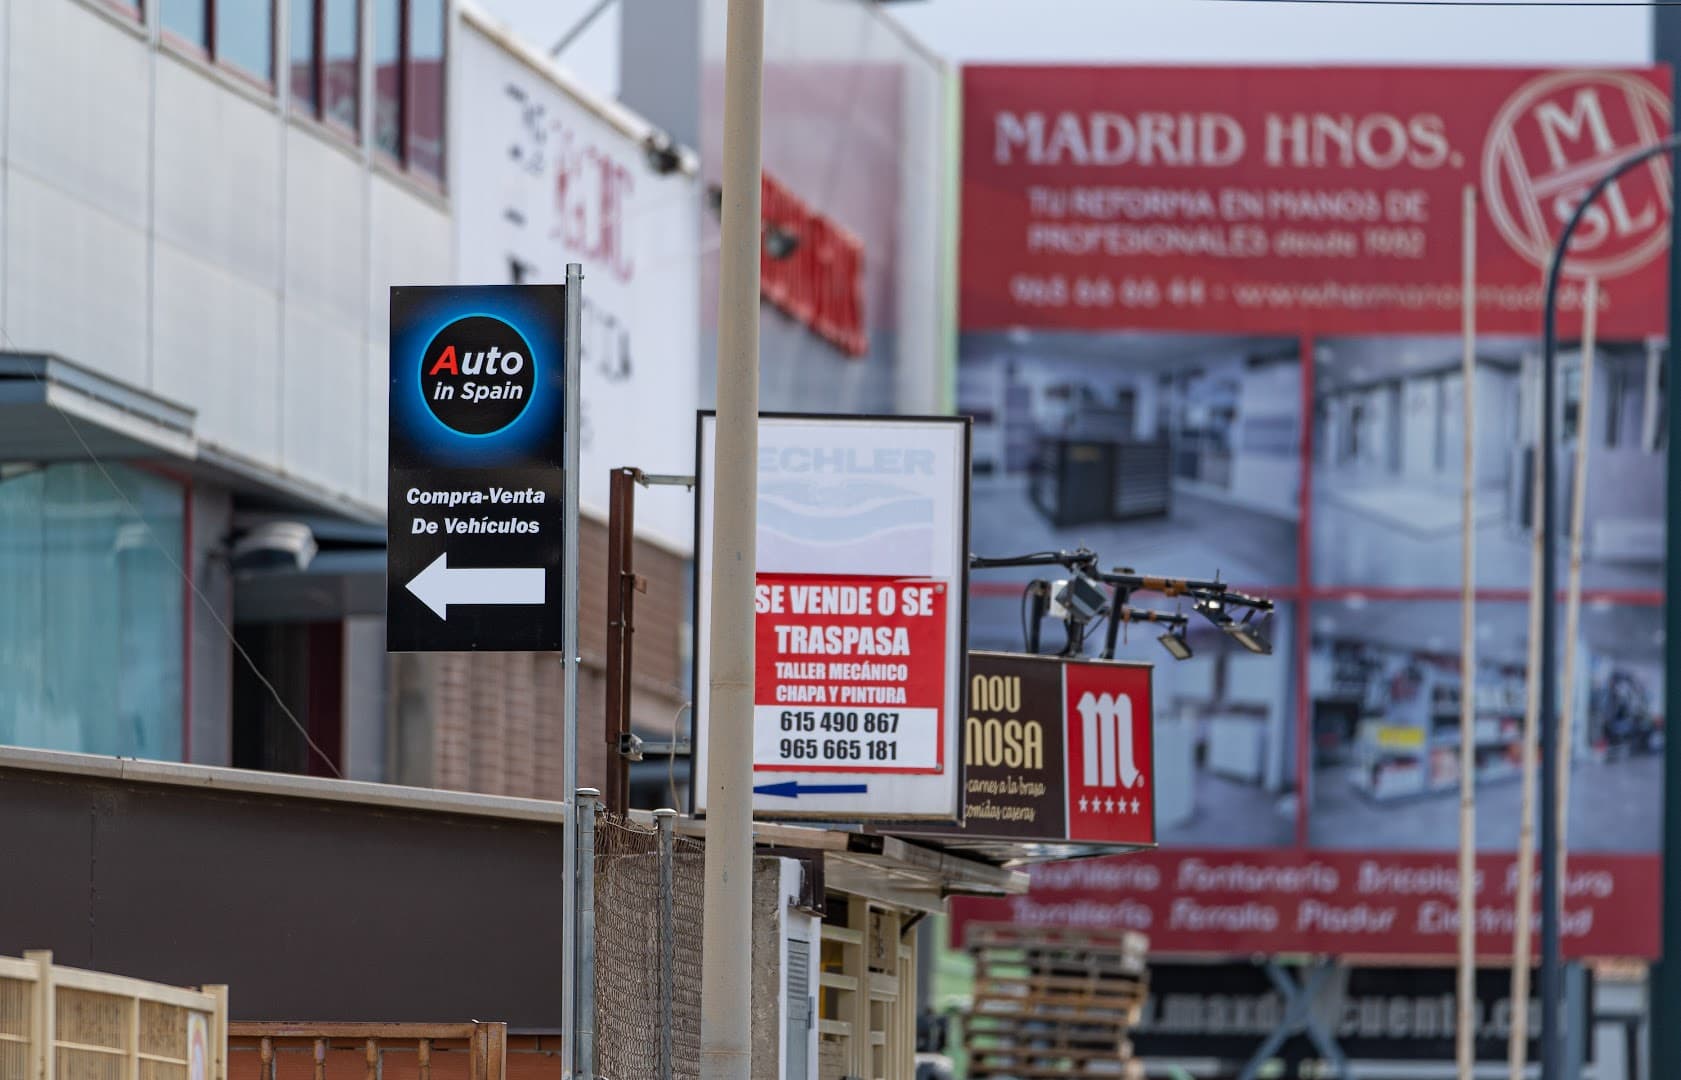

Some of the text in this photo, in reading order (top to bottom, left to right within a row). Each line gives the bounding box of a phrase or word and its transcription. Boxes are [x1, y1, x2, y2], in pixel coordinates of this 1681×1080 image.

[993, 110, 1465, 170] MADRID HNOS.
[1070, 185, 1216, 220] REFORMA
[1218, 187, 1264, 221] EN
[1384, 188, 1429, 222] DE
[1027, 221, 1268, 257] PROFESIONALES
[429, 345, 524, 377] Auto
[432, 380, 524, 403] in Spain
[757, 447, 937, 477] ECHLER
[406, 487, 546, 508] Compra-Venta
[411, 516, 541, 535] De Vehículos
[755, 584, 934, 617] SE VENDE O SE
[774, 625, 911, 656] TRASPASA
[775, 661, 909, 682] TALLER MECÁNICO
[776, 684, 907, 704] CHAPA Y PINTURA
[972, 673, 1021, 713] NOU
[780, 711, 900, 735] 615 490 867
[779, 739, 898, 761] 965 665 181
